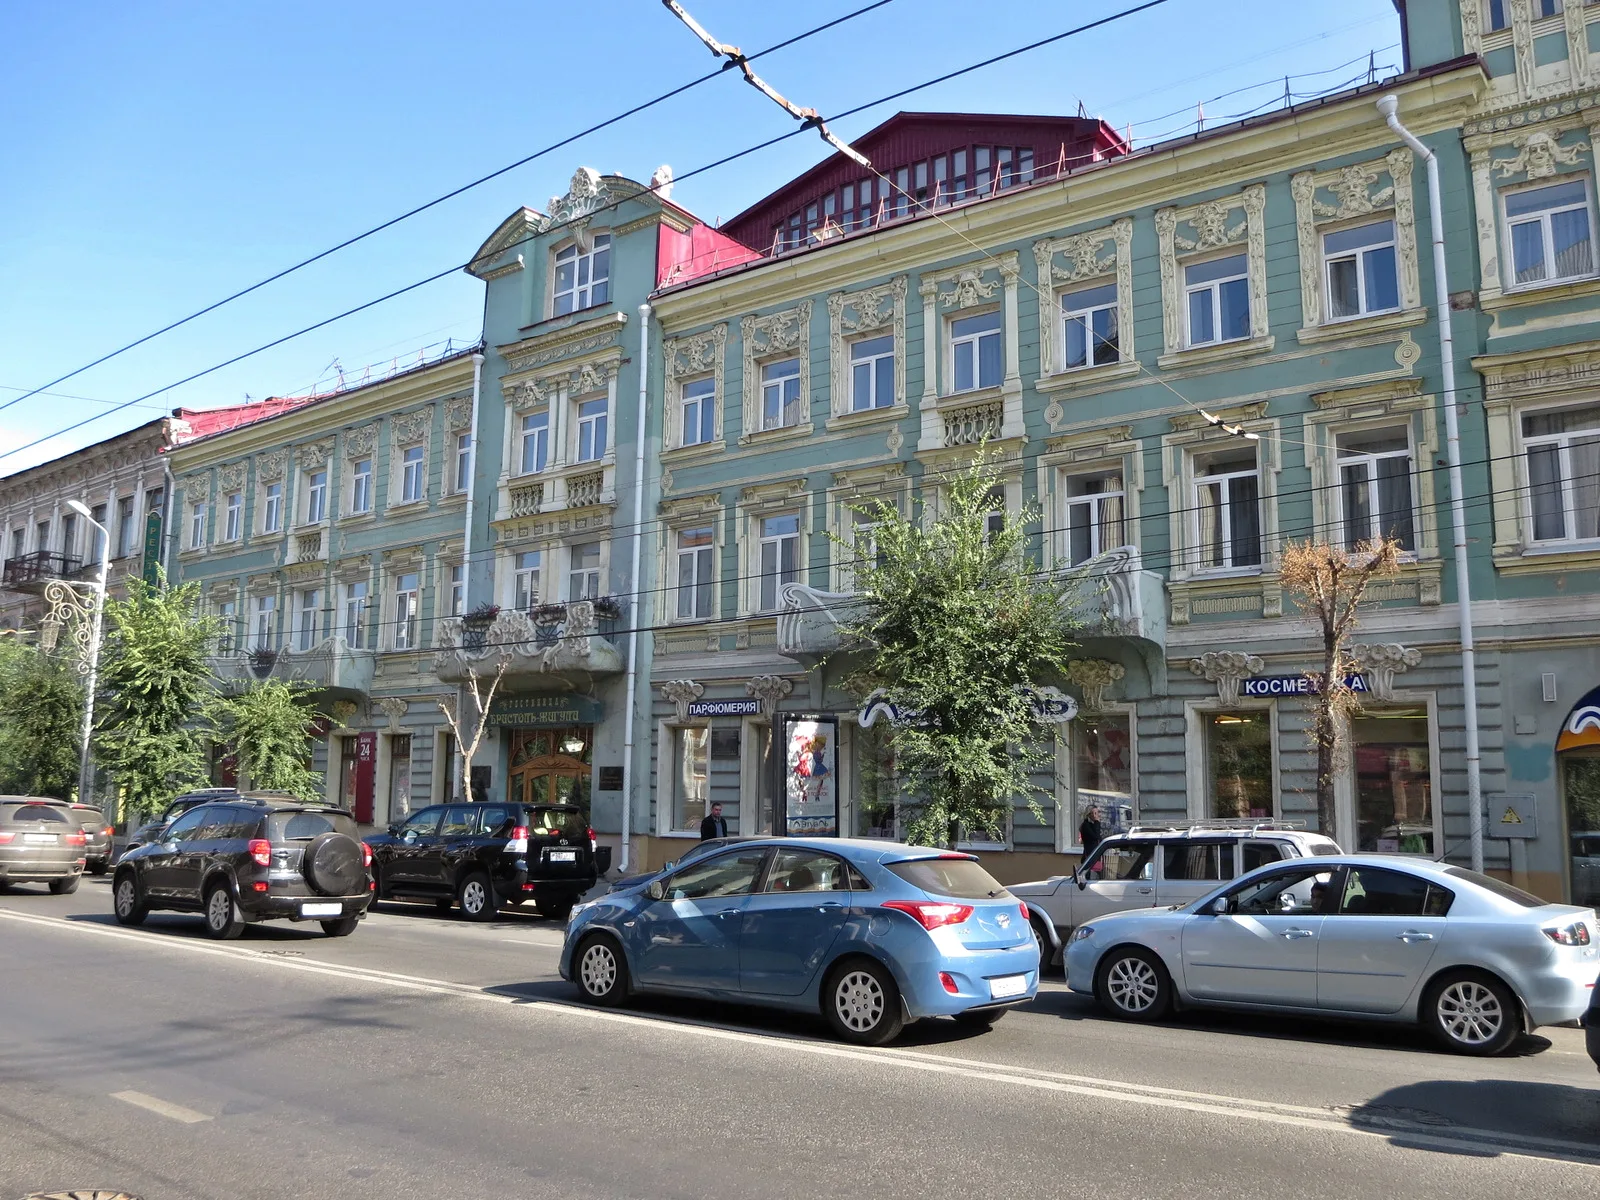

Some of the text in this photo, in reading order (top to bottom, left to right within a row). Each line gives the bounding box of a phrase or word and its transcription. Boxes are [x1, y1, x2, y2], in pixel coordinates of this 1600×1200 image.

[1245, 676, 1364, 694] КОСМЕТКА
[689, 702, 757, 715] ПАРФЮМЕРИЯ
[490, 710, 580, 726] БРИСТОЛЬ-ЖИГУЛИ
[360, 743, 371, 756] 24
